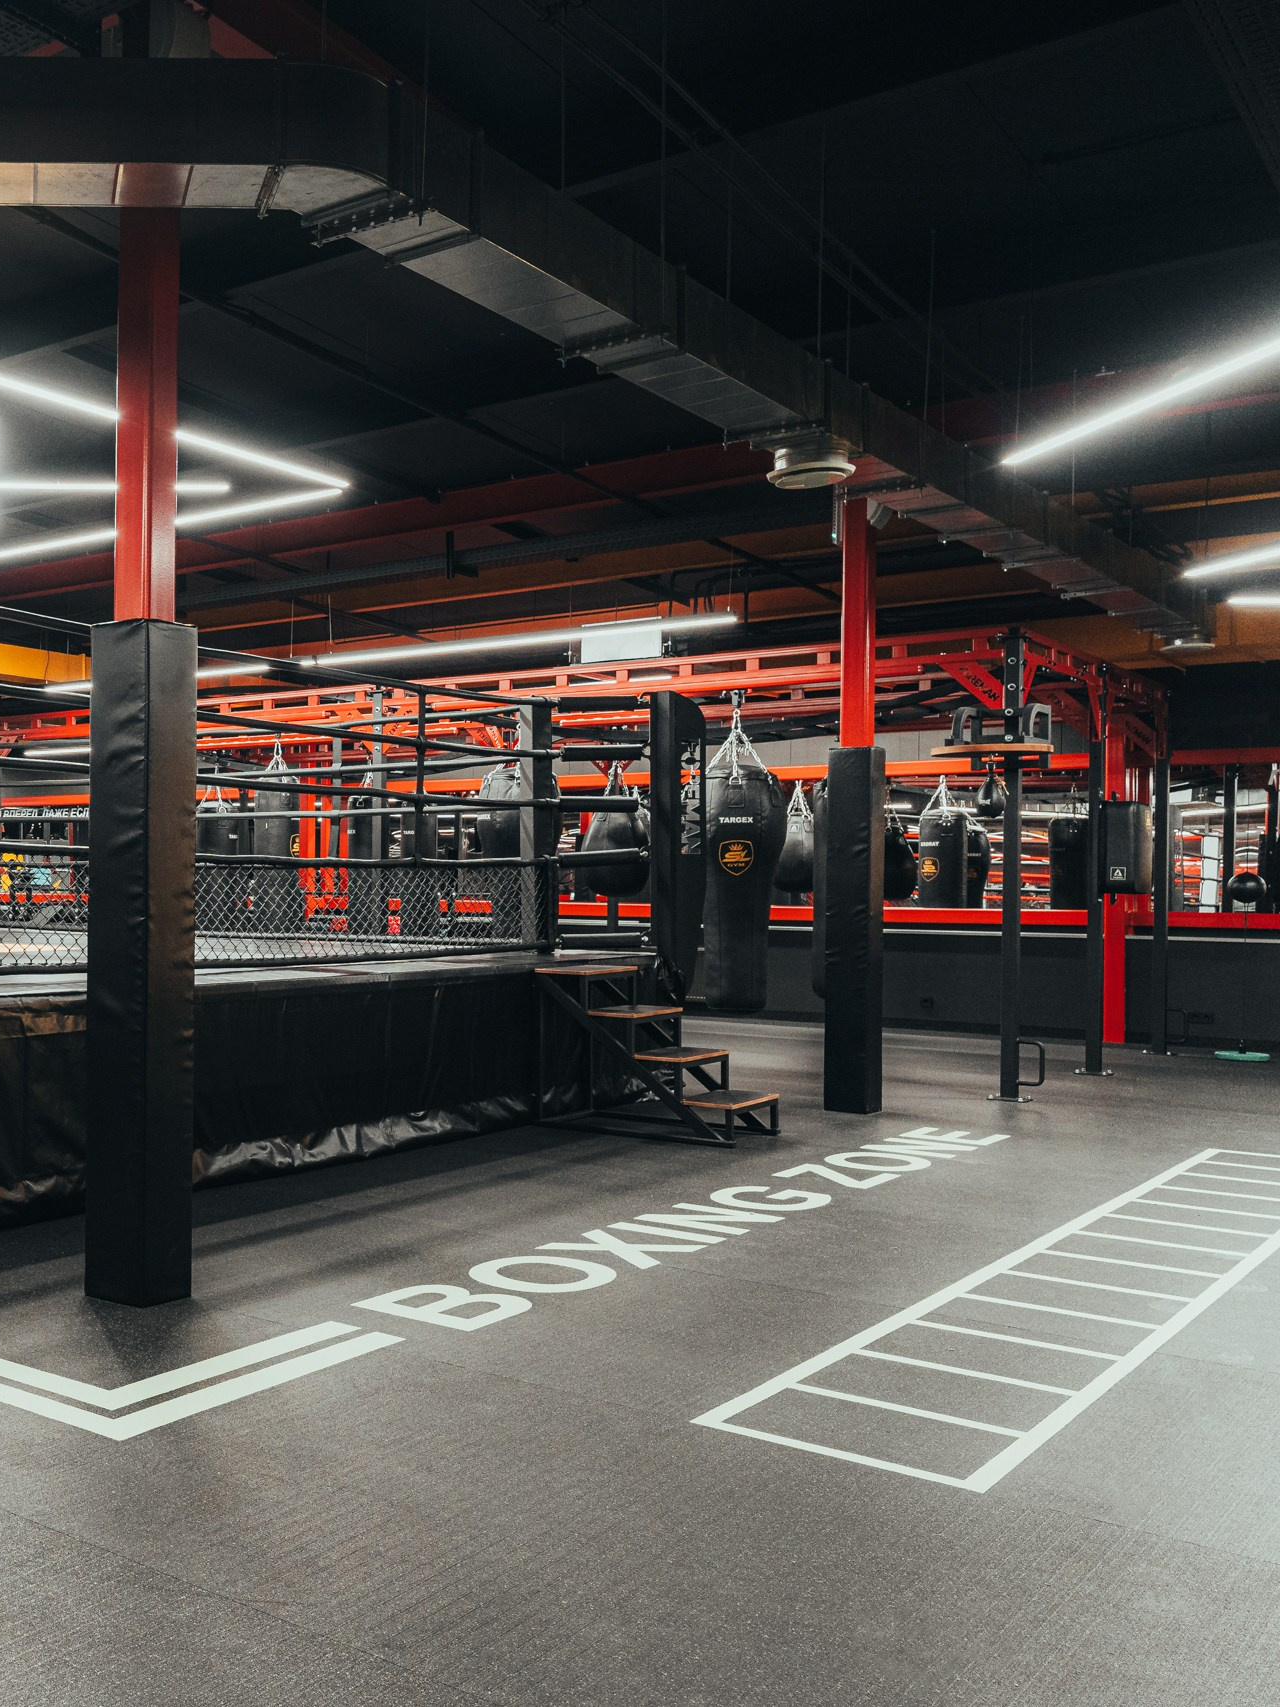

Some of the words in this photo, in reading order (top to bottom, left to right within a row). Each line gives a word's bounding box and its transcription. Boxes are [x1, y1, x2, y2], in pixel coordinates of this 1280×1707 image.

[70, 807, 90, 818] ЕСЛ
[681, 738, 700, 854] FOREMAN
[351, 1185, 832, 1331] BOXING
[771, 1126, 1012, 1190] ZONE
